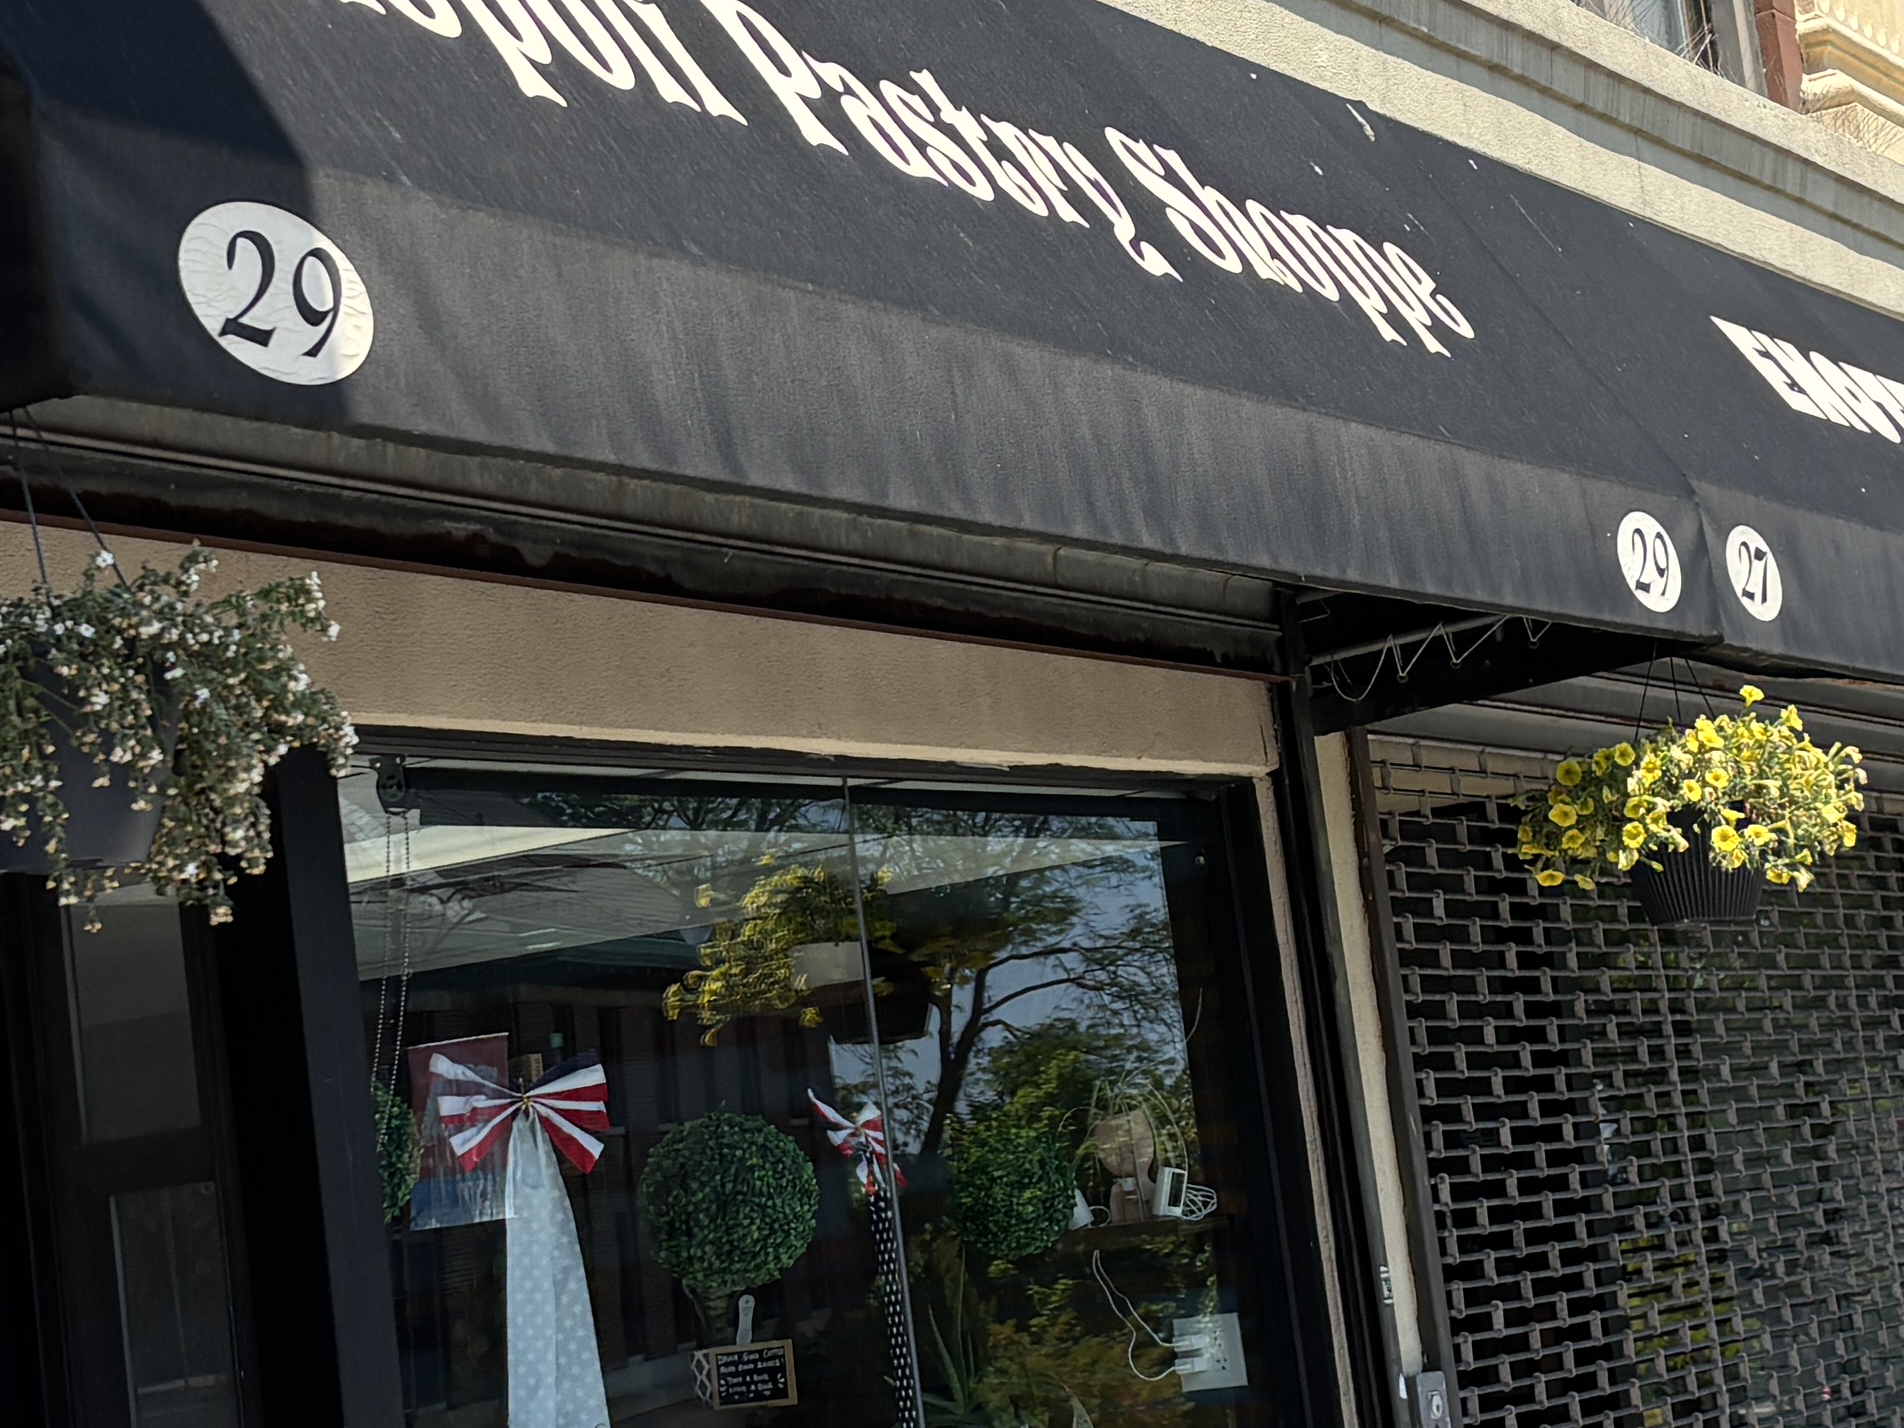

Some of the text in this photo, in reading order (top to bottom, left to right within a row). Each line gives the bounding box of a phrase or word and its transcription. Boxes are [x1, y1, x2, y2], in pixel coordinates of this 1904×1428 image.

[1104, 125, 1476, 358] Shoppe
[218, 230, 342, 358] 29
[1632, 528, 1669, 596] 29
[1738, 541, 1768, 605] 27
